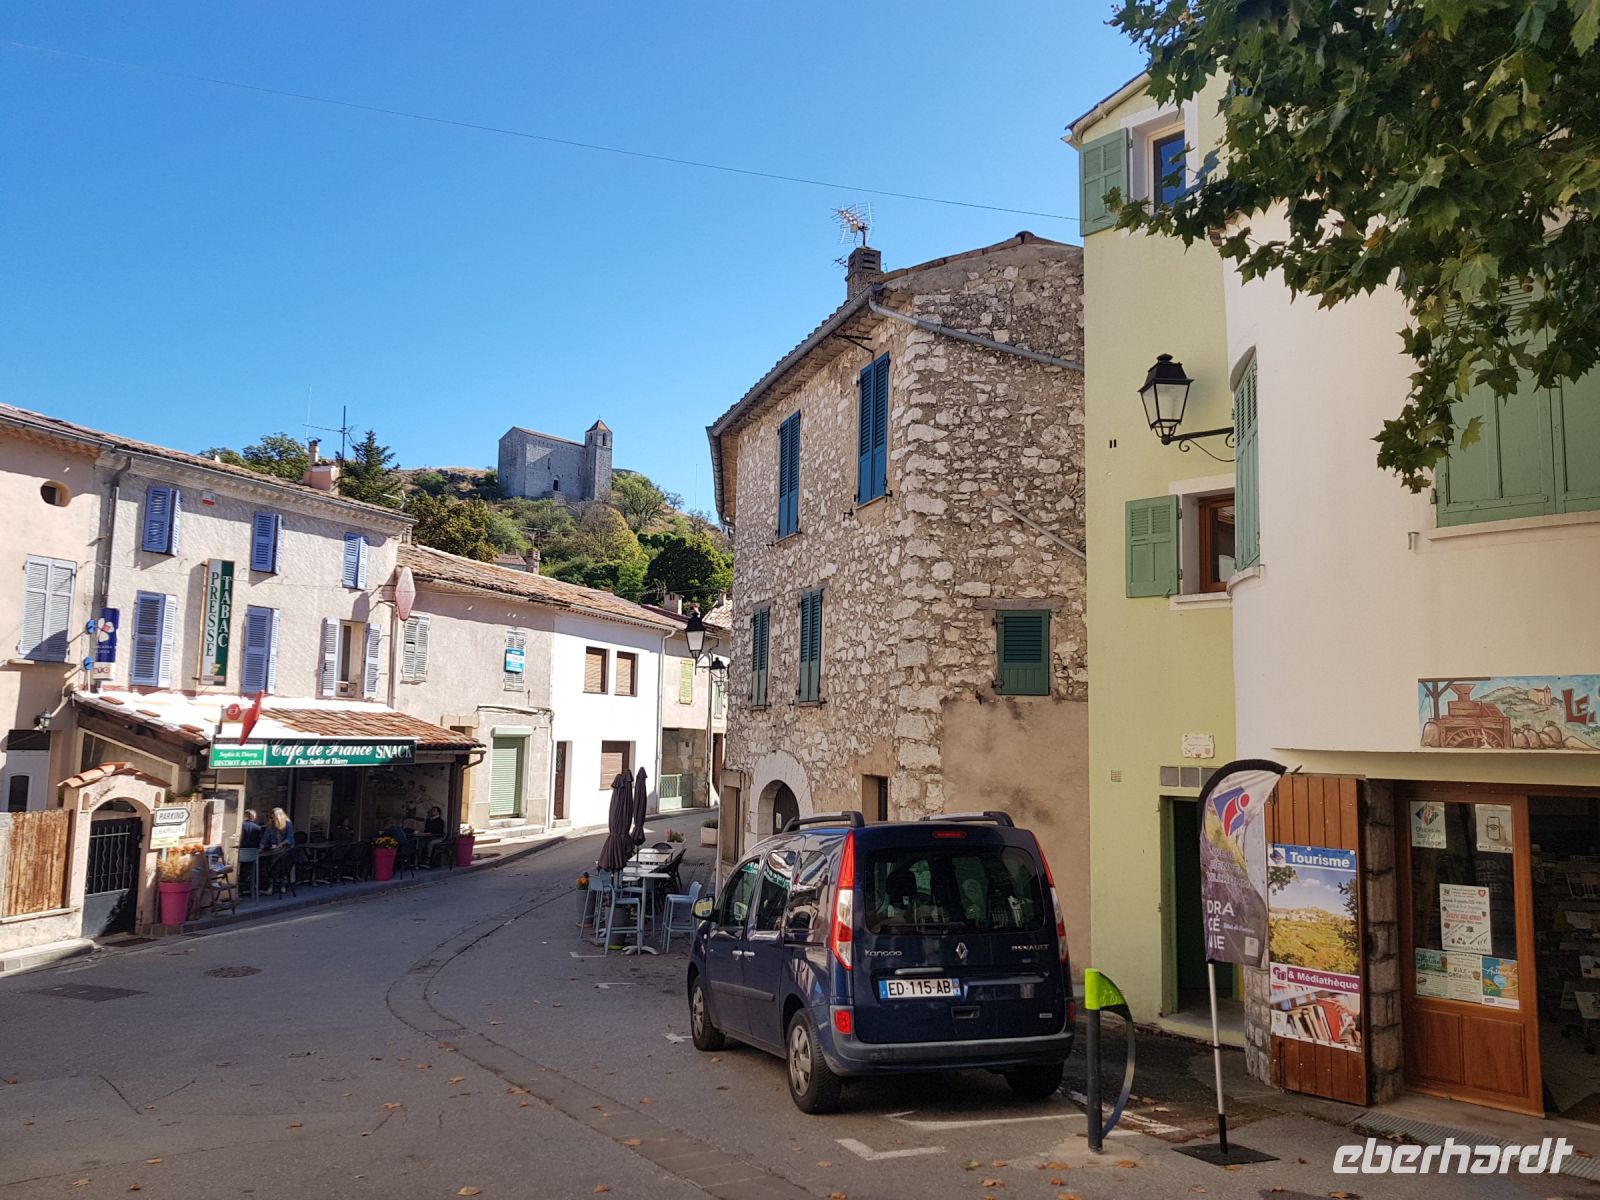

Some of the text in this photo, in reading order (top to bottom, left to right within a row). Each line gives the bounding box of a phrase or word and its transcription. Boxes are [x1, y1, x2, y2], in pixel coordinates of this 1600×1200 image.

[206, 571, 219, 657] PRESSE
[218, 575, 232, 648] TABAC
[270, 740, 412, 765] Café de France SNACK
[158, 811, 185, 821] PARKING
[1289, 851, 1351, 868] Tourisme
[1206, 899, 1235, 917] DRA
[1011, 943, 1050, 952] RENAULT
[1288, 970, 1358, 990] & Médiathèque
